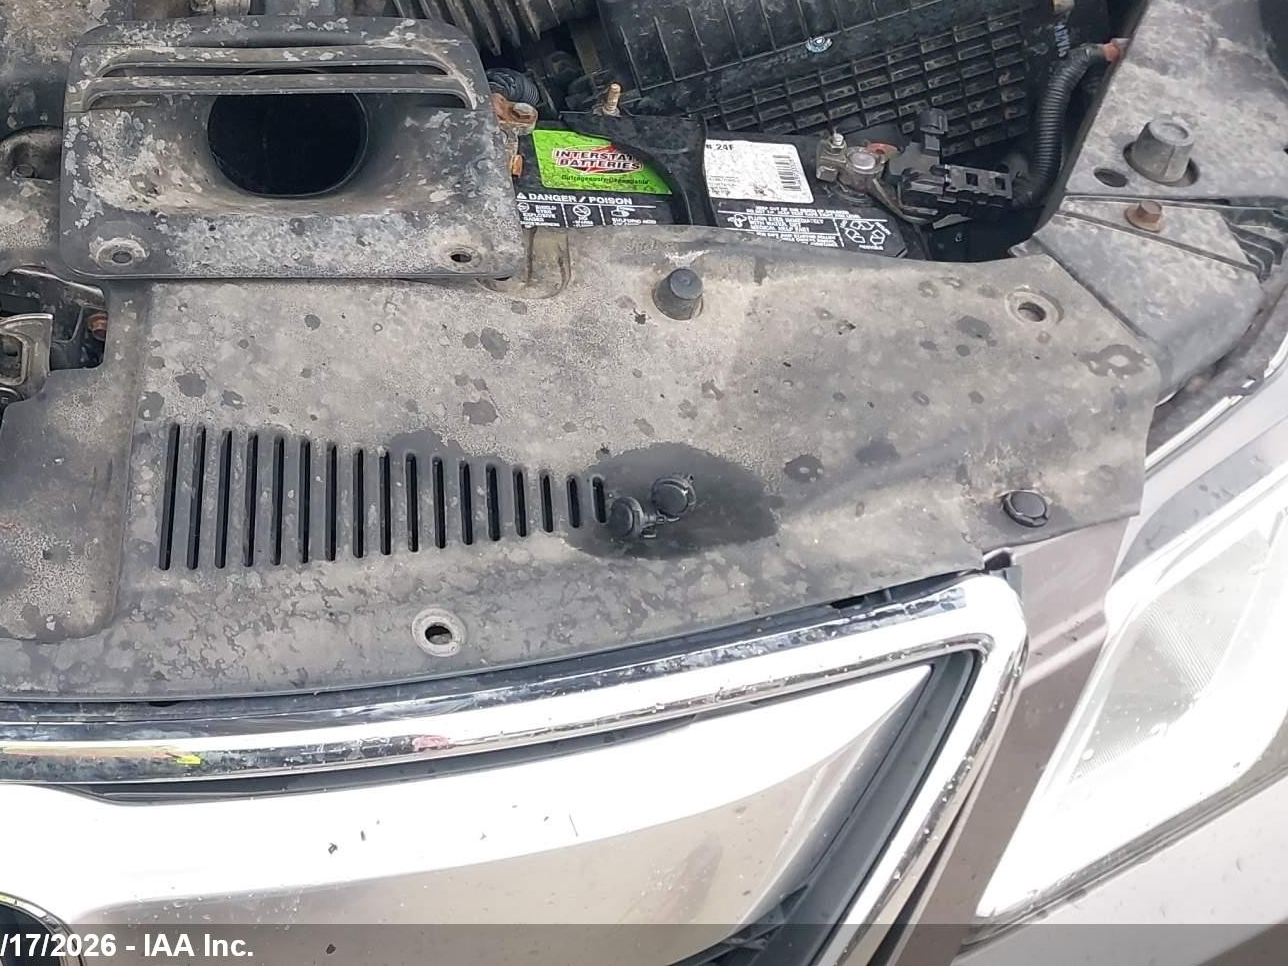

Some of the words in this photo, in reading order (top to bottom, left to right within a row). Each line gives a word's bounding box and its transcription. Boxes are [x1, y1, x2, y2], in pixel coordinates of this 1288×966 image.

[555, 149, 637, 163] INTERSTAT
[559, 158, 642, 170] BATTERIES
[528, 193, 577, 203] DANGER
[588, 196, 633, 205] POISON
